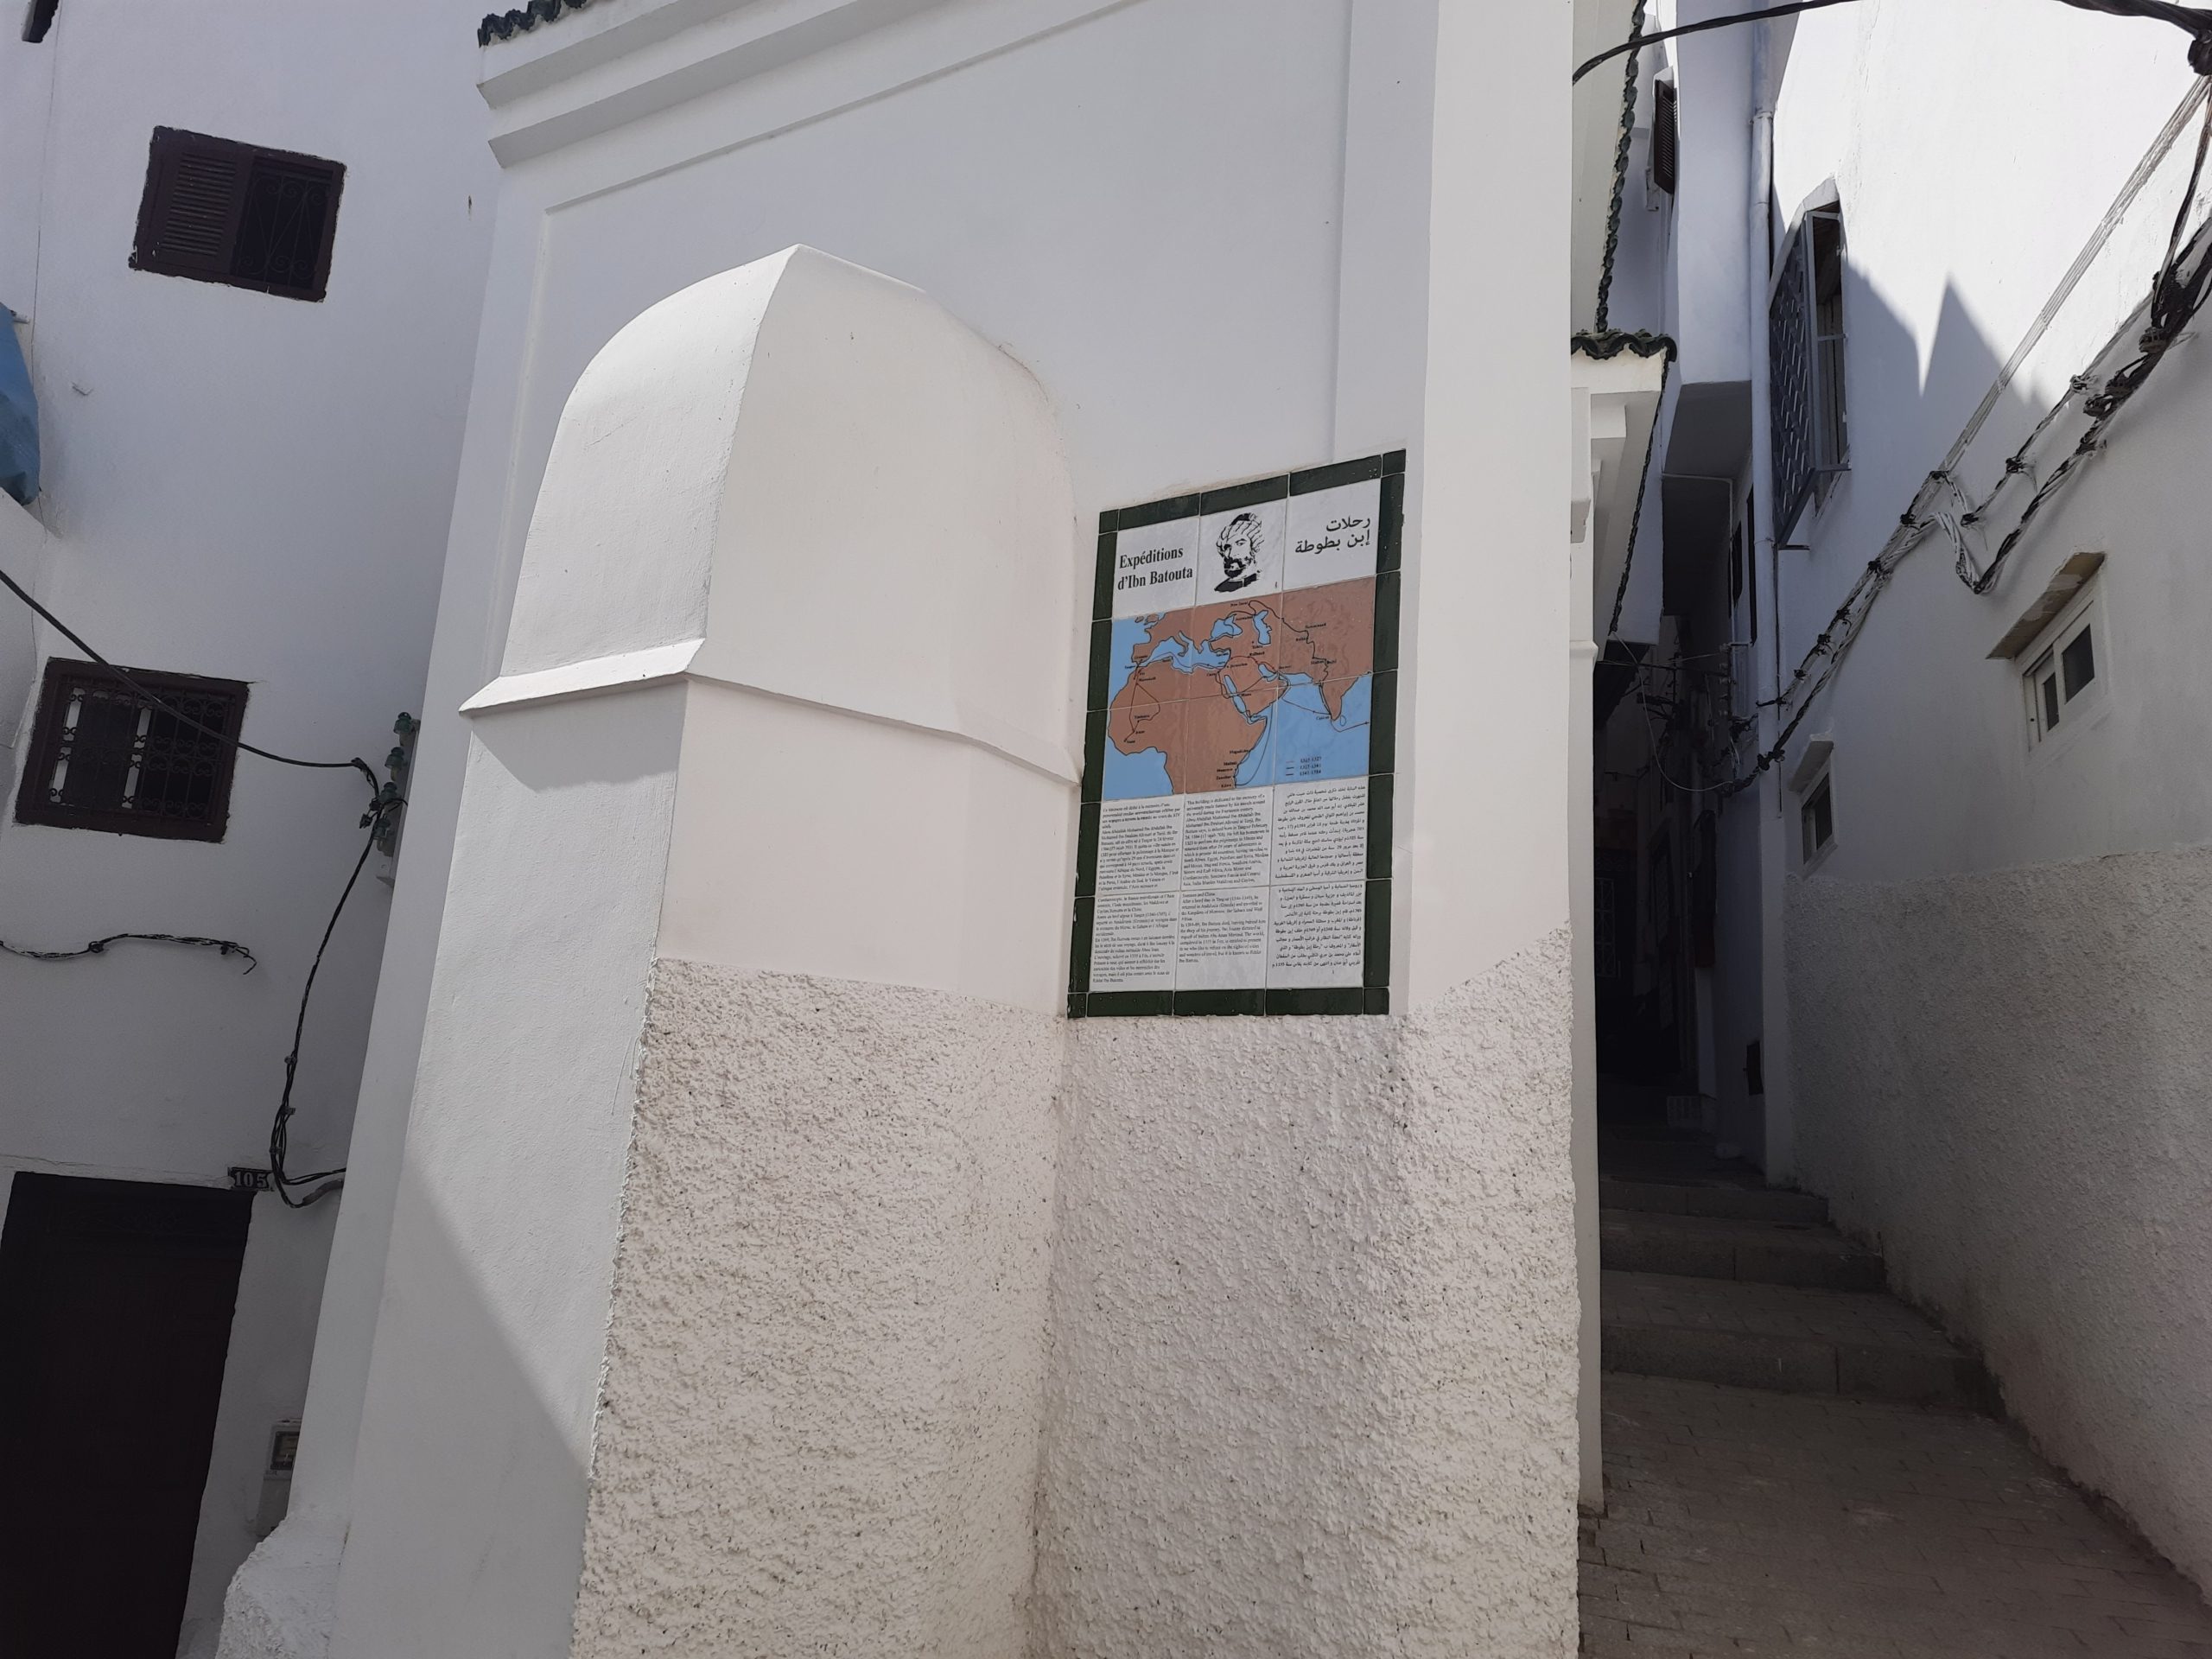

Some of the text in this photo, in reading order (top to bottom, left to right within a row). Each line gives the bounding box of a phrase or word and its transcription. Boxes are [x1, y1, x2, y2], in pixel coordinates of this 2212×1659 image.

[1326, 515, 1370, 531] رحلات
[1295, 529, 1370, 554] إبن بطوطة
[1119, 547, 1184, 569] Expéditions
[1117, 567, 1192, 590] d'Ibn Batouta
[235, 1171, 268, 1188] 105
